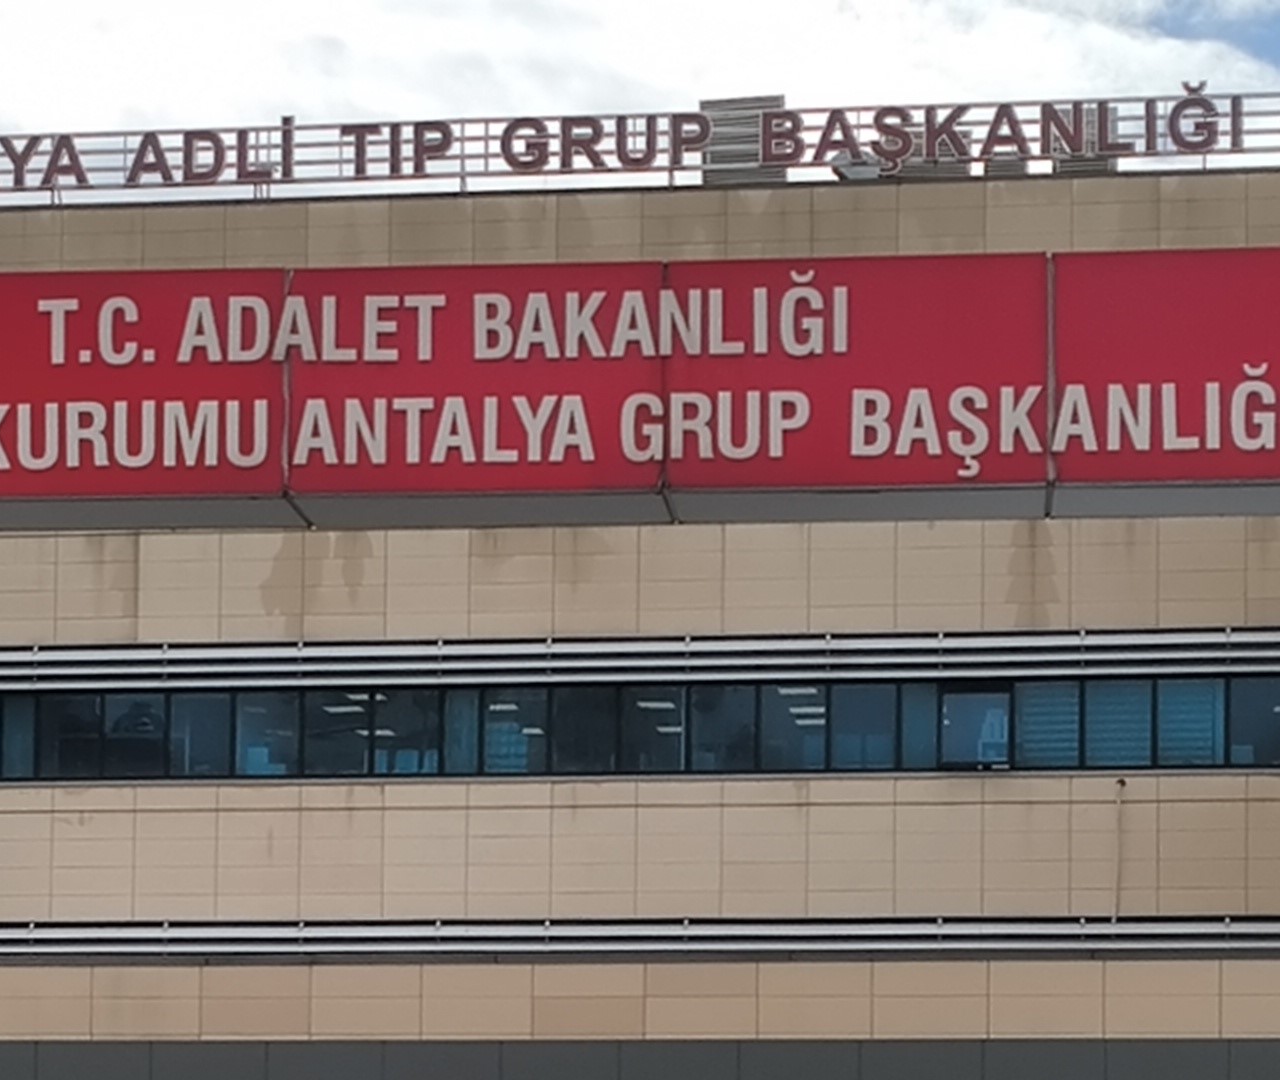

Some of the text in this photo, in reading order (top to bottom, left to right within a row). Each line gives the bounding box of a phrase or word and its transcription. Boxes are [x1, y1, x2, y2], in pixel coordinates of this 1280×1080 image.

[124, 115, 294, 186] ADLİ
[341, 120, 453, 179] TIP
[500, 113, 713, 174] GRUP
[760, 80, 1244, 176] BAŞKANLIĞI
[37, 269, 849, 365] T.C. ADALET BAKANLIĞI
[292, 394, 596, 466] ANTALYA
[620, 389, 811, 463] GRUP
